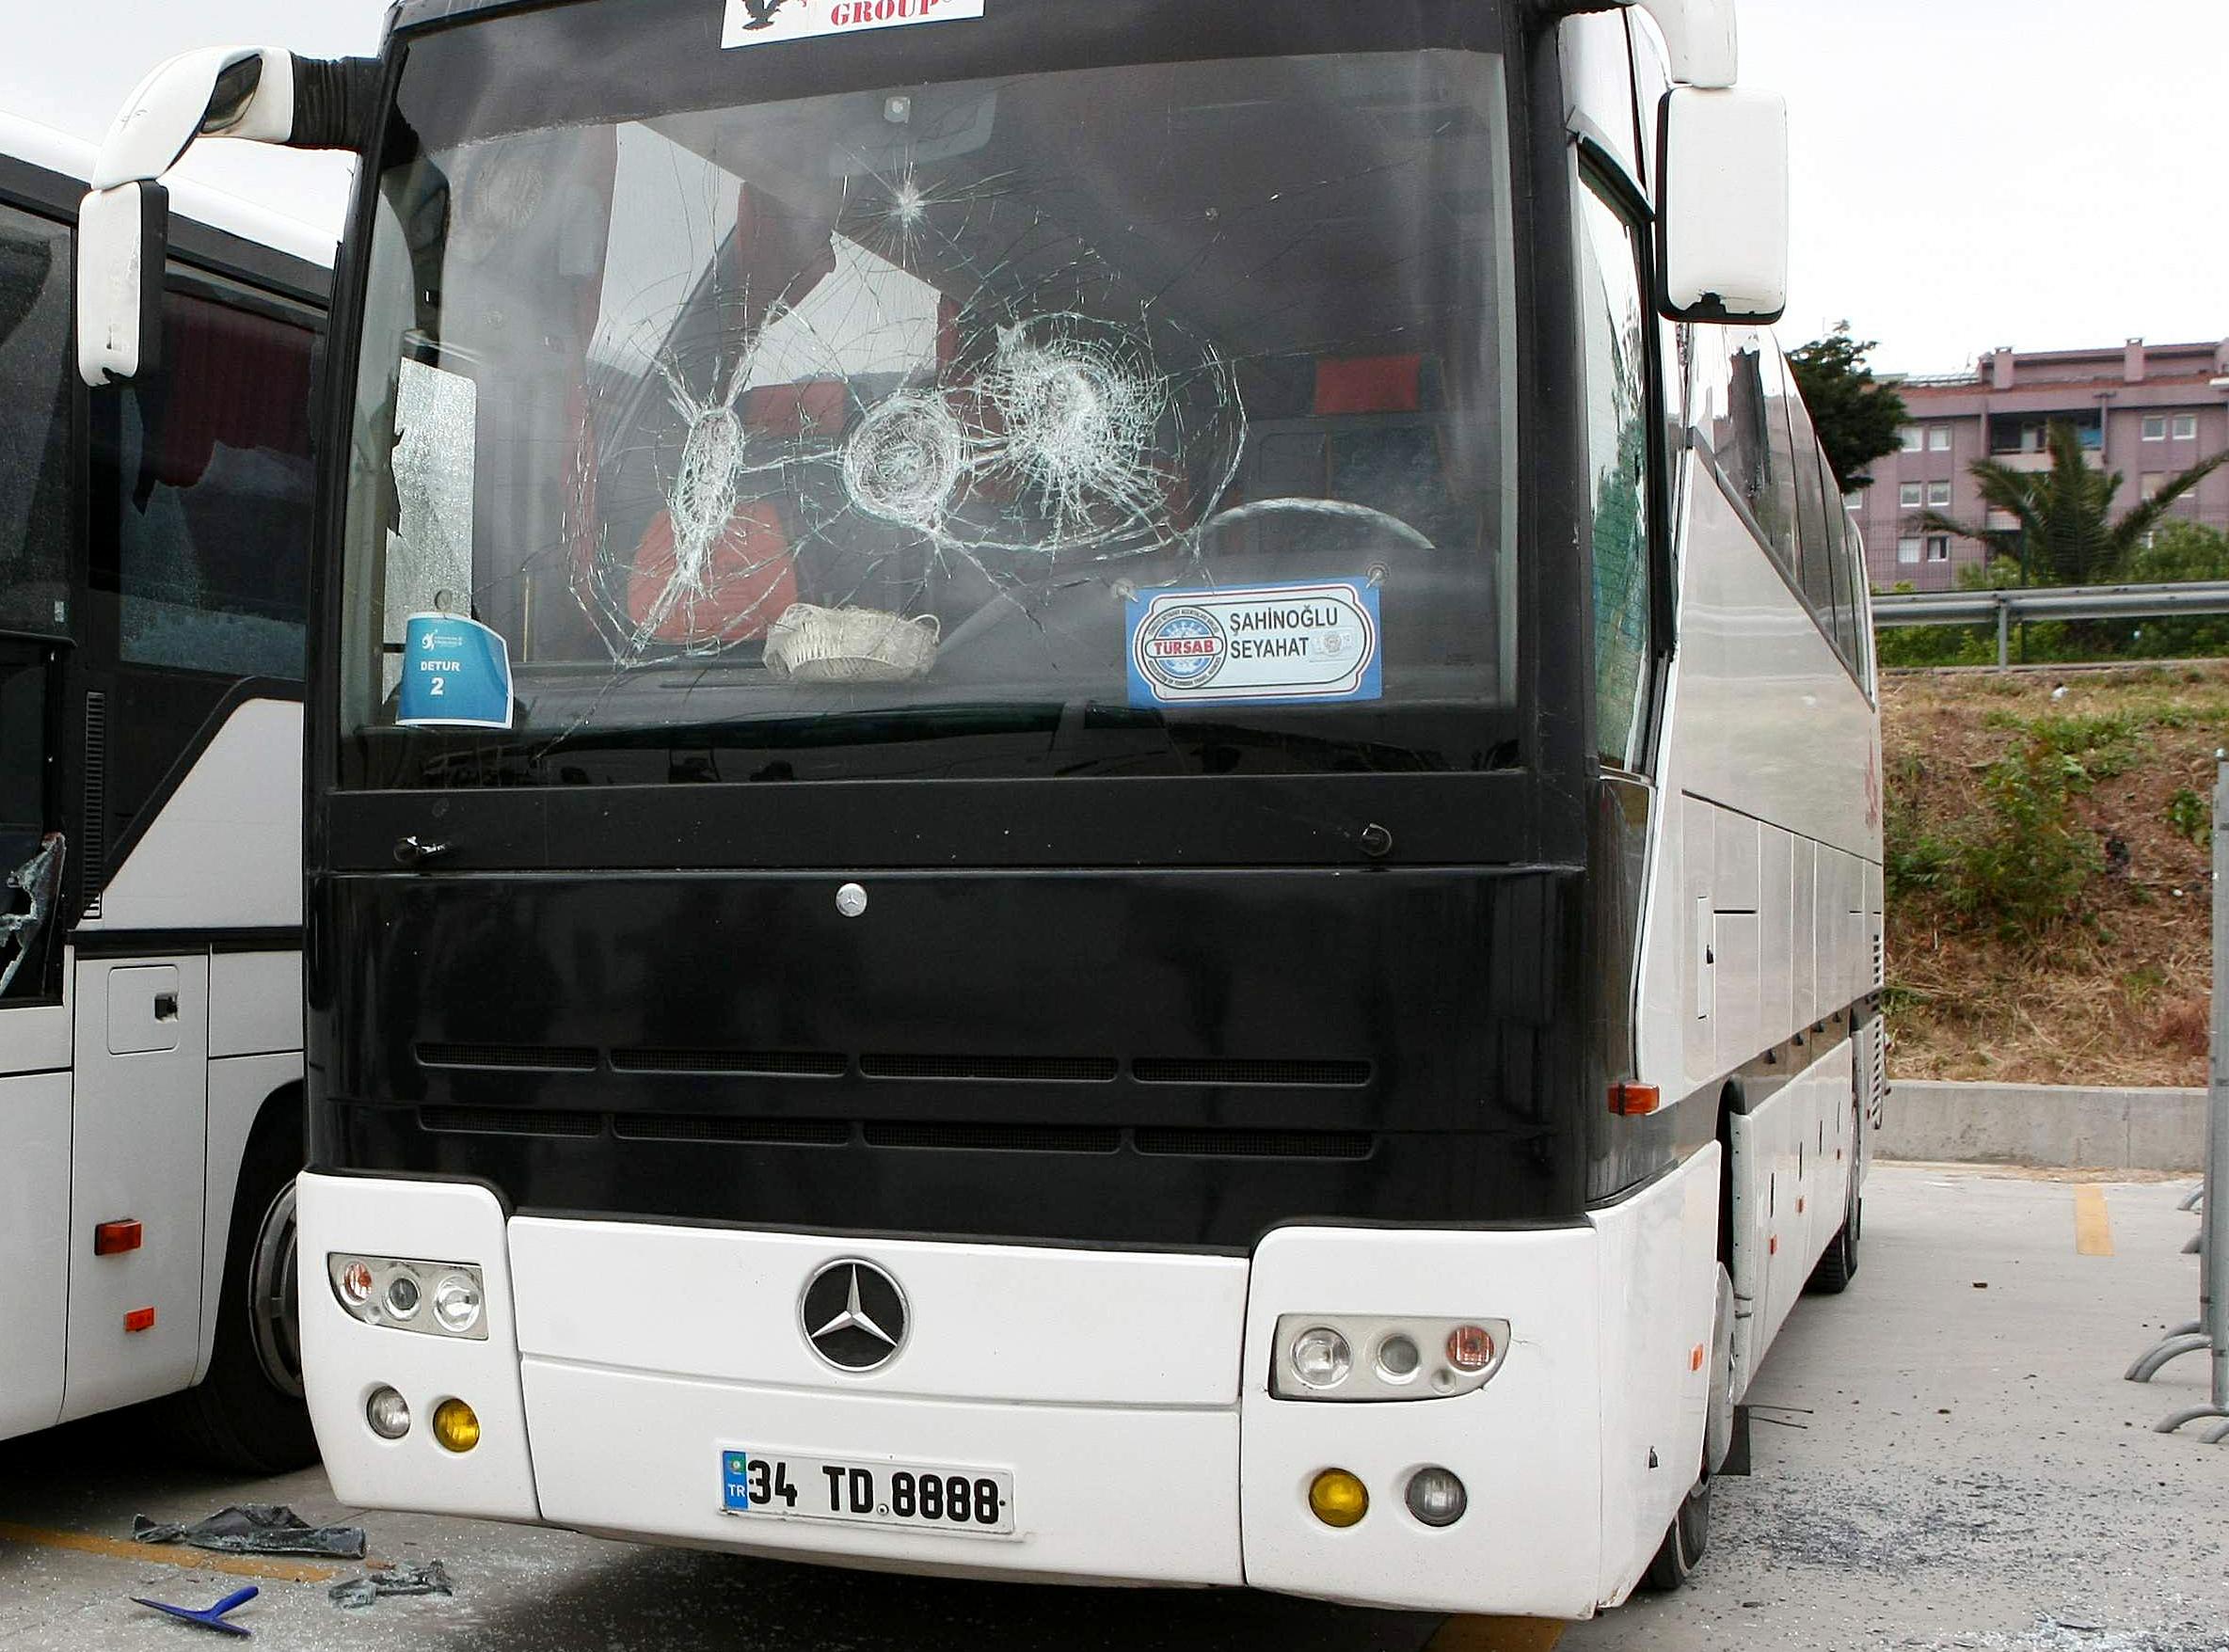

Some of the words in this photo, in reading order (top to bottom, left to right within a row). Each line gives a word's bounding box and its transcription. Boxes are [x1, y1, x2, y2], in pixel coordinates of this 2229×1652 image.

[831, 0, 938, 25] GROUP
[1230, 606, 1338, 635] ŞAHİNOĞLU
[1230, 637, 1310, 659] SEYAHAT
[421, 661, 460, 671] DETUR
[430, 677, 444, 695] 2
[727, 1482, 745, 1497] TR
[748, 1459, 797, 1507] 34
[822, 1465, 874, 1514] TD
[891, 1471, 999, 1524] 8888
